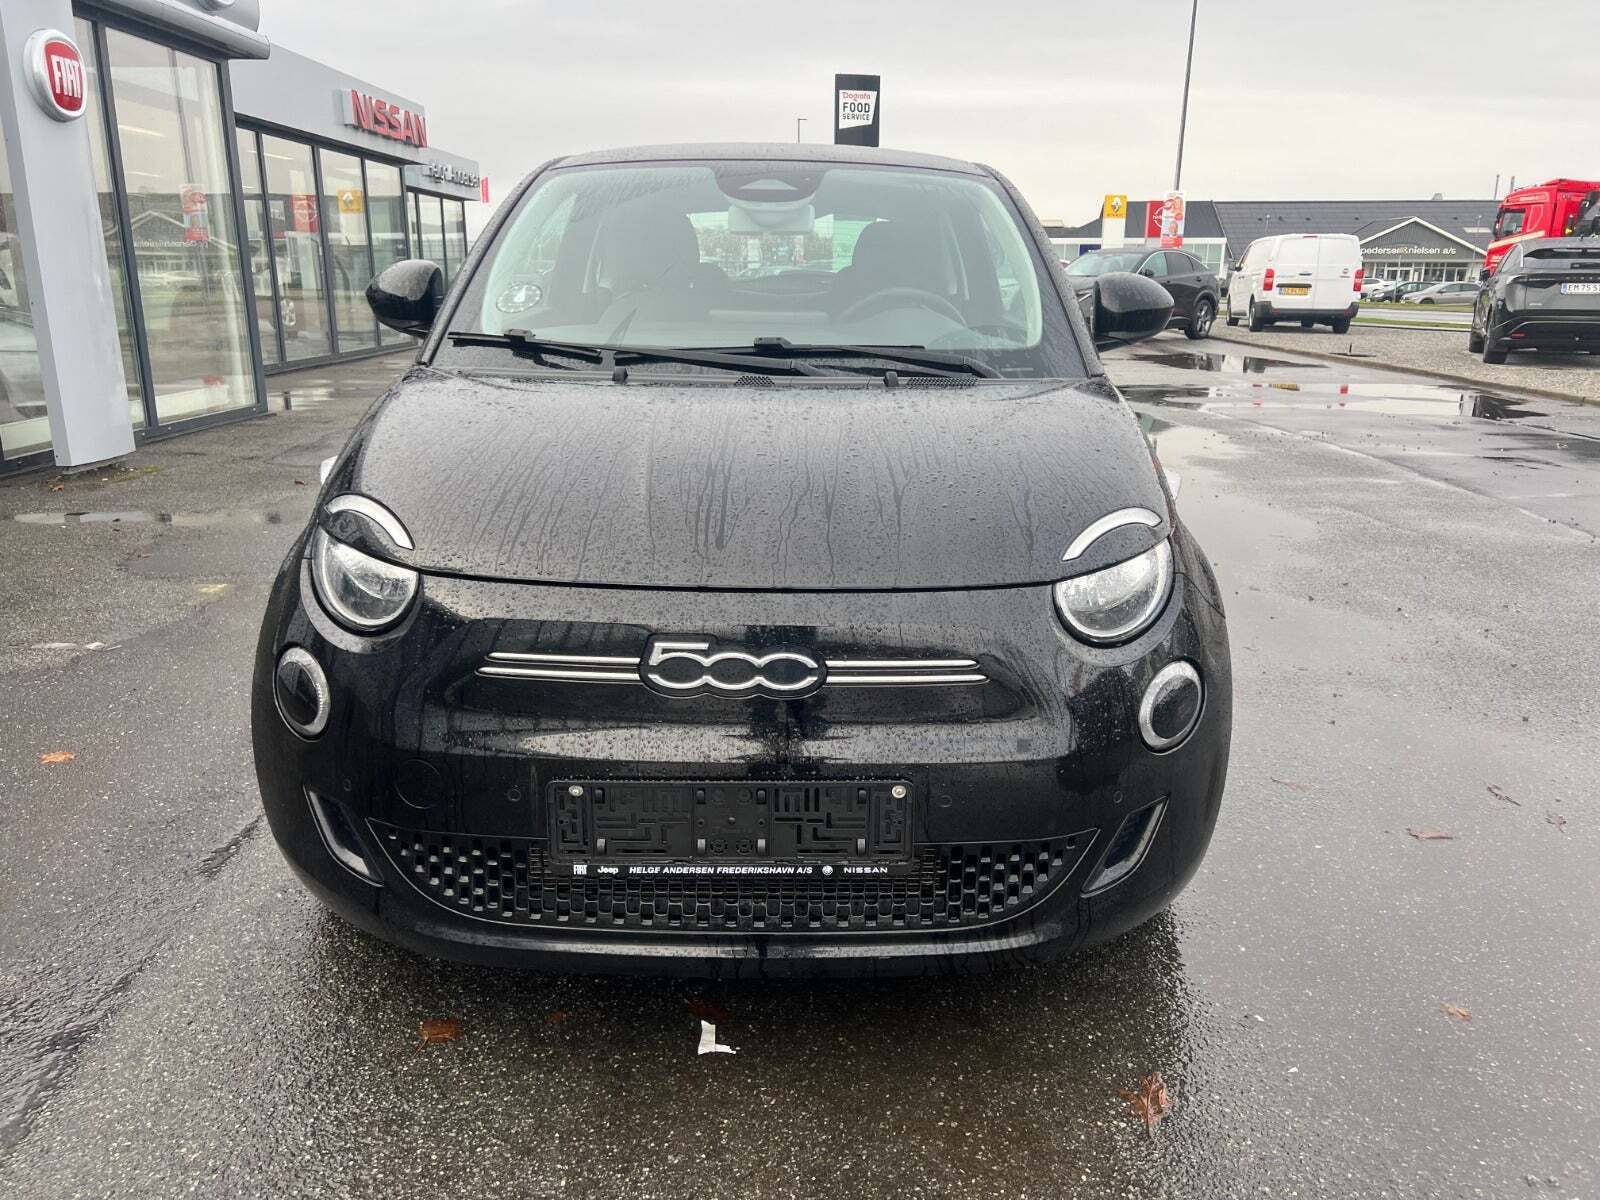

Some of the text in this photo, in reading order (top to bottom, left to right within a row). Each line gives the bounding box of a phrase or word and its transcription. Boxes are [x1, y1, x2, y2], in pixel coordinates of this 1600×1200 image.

[51, 54, 82, 98] FIAT
[842, 102, 870, 113] FOOD
[351, 88, 428, 148] NISSAN
[842, 113, 870, 121] SERVICE
[1408, 245, 1440, 255] nielsen
[1442, 247, 1456, 255] a/s
[648, 641, 818, 692] 500
[573, 864, 587, 875] FIAT
[597, 866, 619, 875] Jeep
[662, 866, 714, 875] ANDERSEN
[716, 866, 794, 875] FREDERIKSHAVN
[796, 866, 813, 875] A/S
